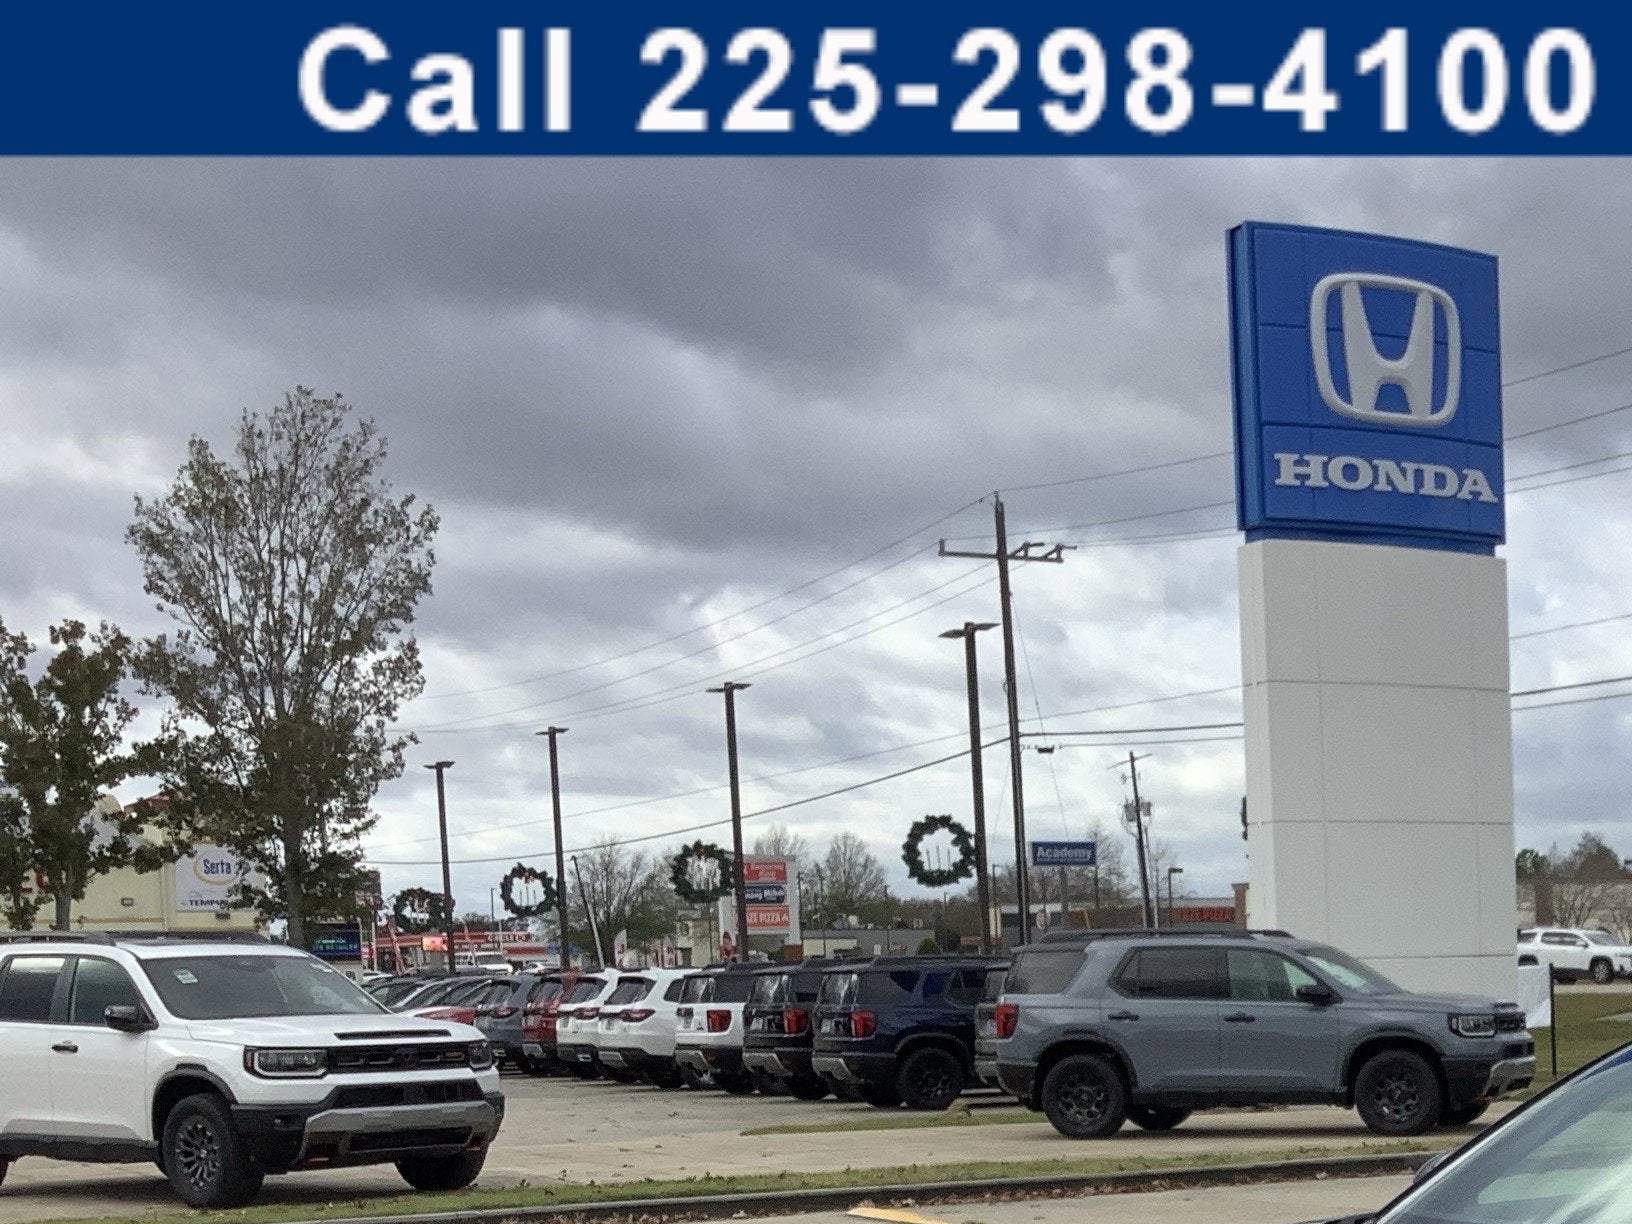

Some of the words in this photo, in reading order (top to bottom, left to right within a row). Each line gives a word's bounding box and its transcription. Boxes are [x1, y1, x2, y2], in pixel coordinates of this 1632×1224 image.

[1274, 452, 1499, 503] HONDA
[1037, 846, 1092, 860] Academy
[203, 858, 232, 875] Serta
